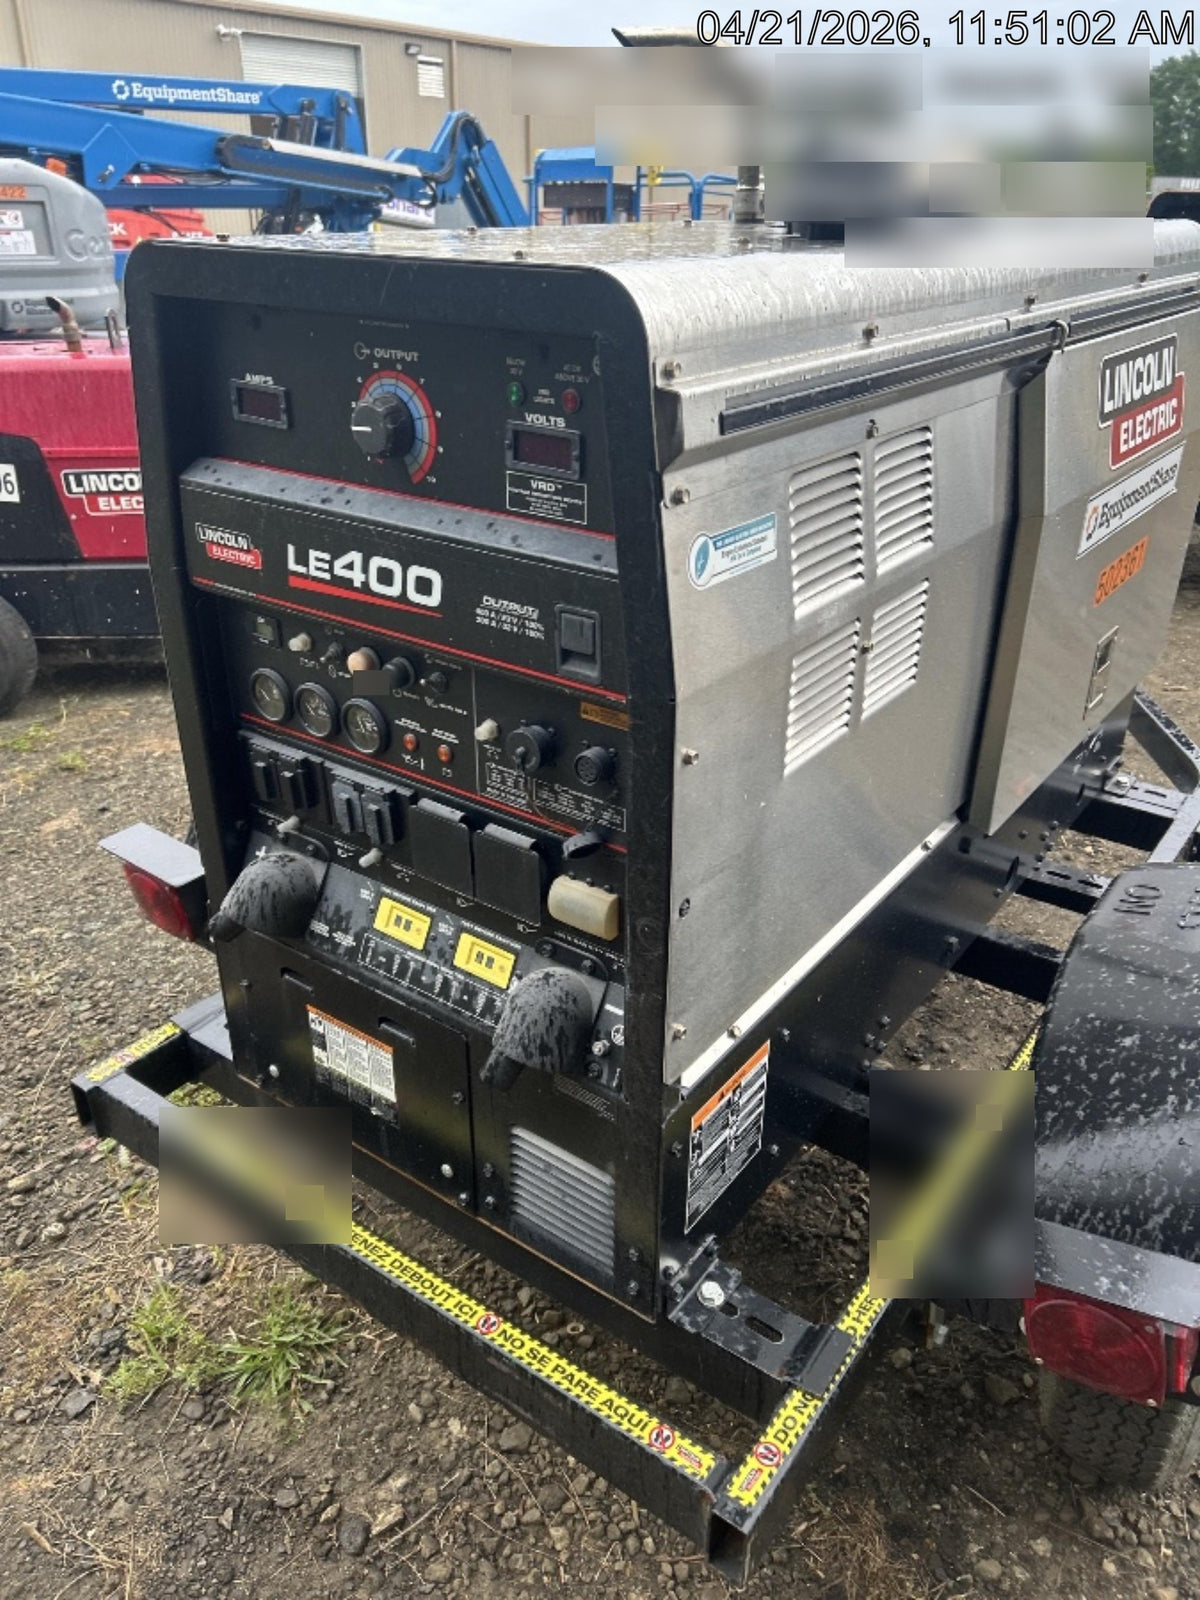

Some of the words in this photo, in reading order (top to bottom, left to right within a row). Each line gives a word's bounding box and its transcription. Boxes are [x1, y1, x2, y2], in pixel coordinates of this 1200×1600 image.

[374, 347, 419, 362] OUTPUT
[245, 372, 274, 385] AMPS
[1103, 346, 1175, 413] LINCOLN
[524, 411, 566, 428] VOLTS
[1119, 397, 1178, 454] ELECTRIC
[198, 526, 248, 550] LINCOLN
[287, 543, 443, 608] LE400
[389, 1258, 456, 1303] DEBOUT
[453, 1300, 479, 1320] ICI
[498, 1329, 525, 1350] NO
[526, 1346, 553, 1368] SE
[551, 1363, 601, 1400] PARE
[600, 1397, 650, 1433] AQUÍ
[773, 1415, 797, 1444] DO
